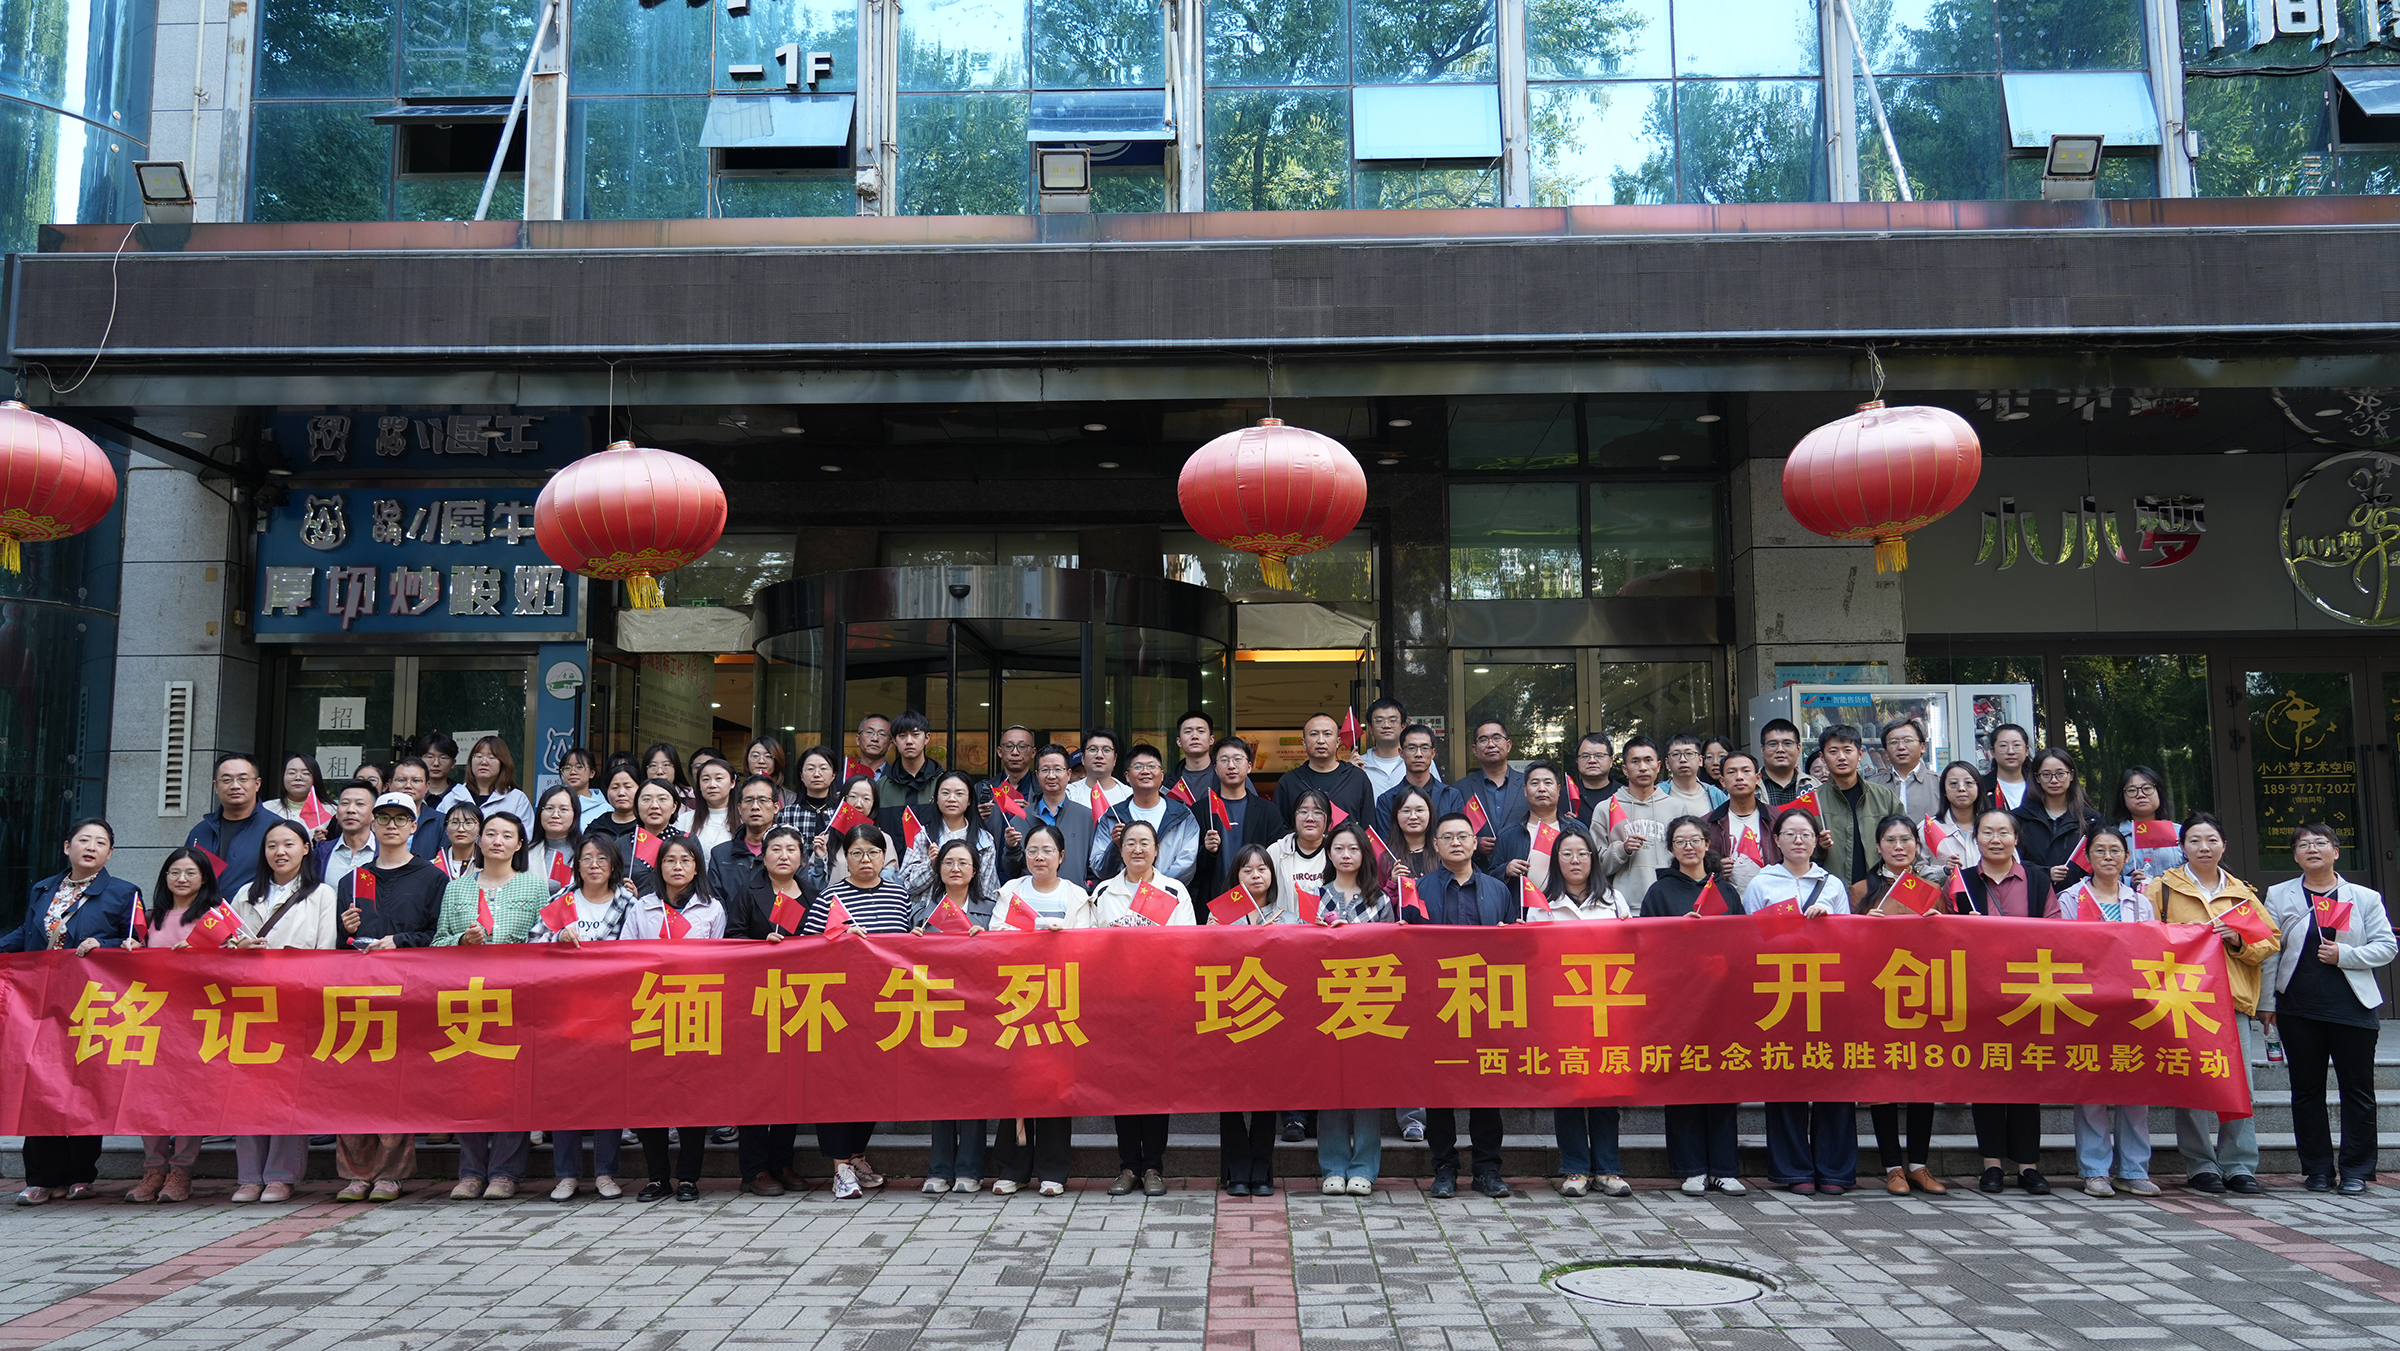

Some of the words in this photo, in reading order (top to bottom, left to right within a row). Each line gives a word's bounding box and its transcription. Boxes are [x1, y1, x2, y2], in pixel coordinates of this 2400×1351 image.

[1974, 495, 2207, 571] 小小梦
[262, 565, 565, 631] 厚切炒酸奶
[2257, 761, 2356, 775] 小小梦艺术空间
[2263, 783, 2356, 795] 189-9727-2027
[68, 976, 522, 1066] 铭记历史
[630, 961, 1090, 1057] 缅怀先烈
[1194, 953, 1646, 1044] 珍爱和平
[1753, 947, 2222, 1039] 开创未来
